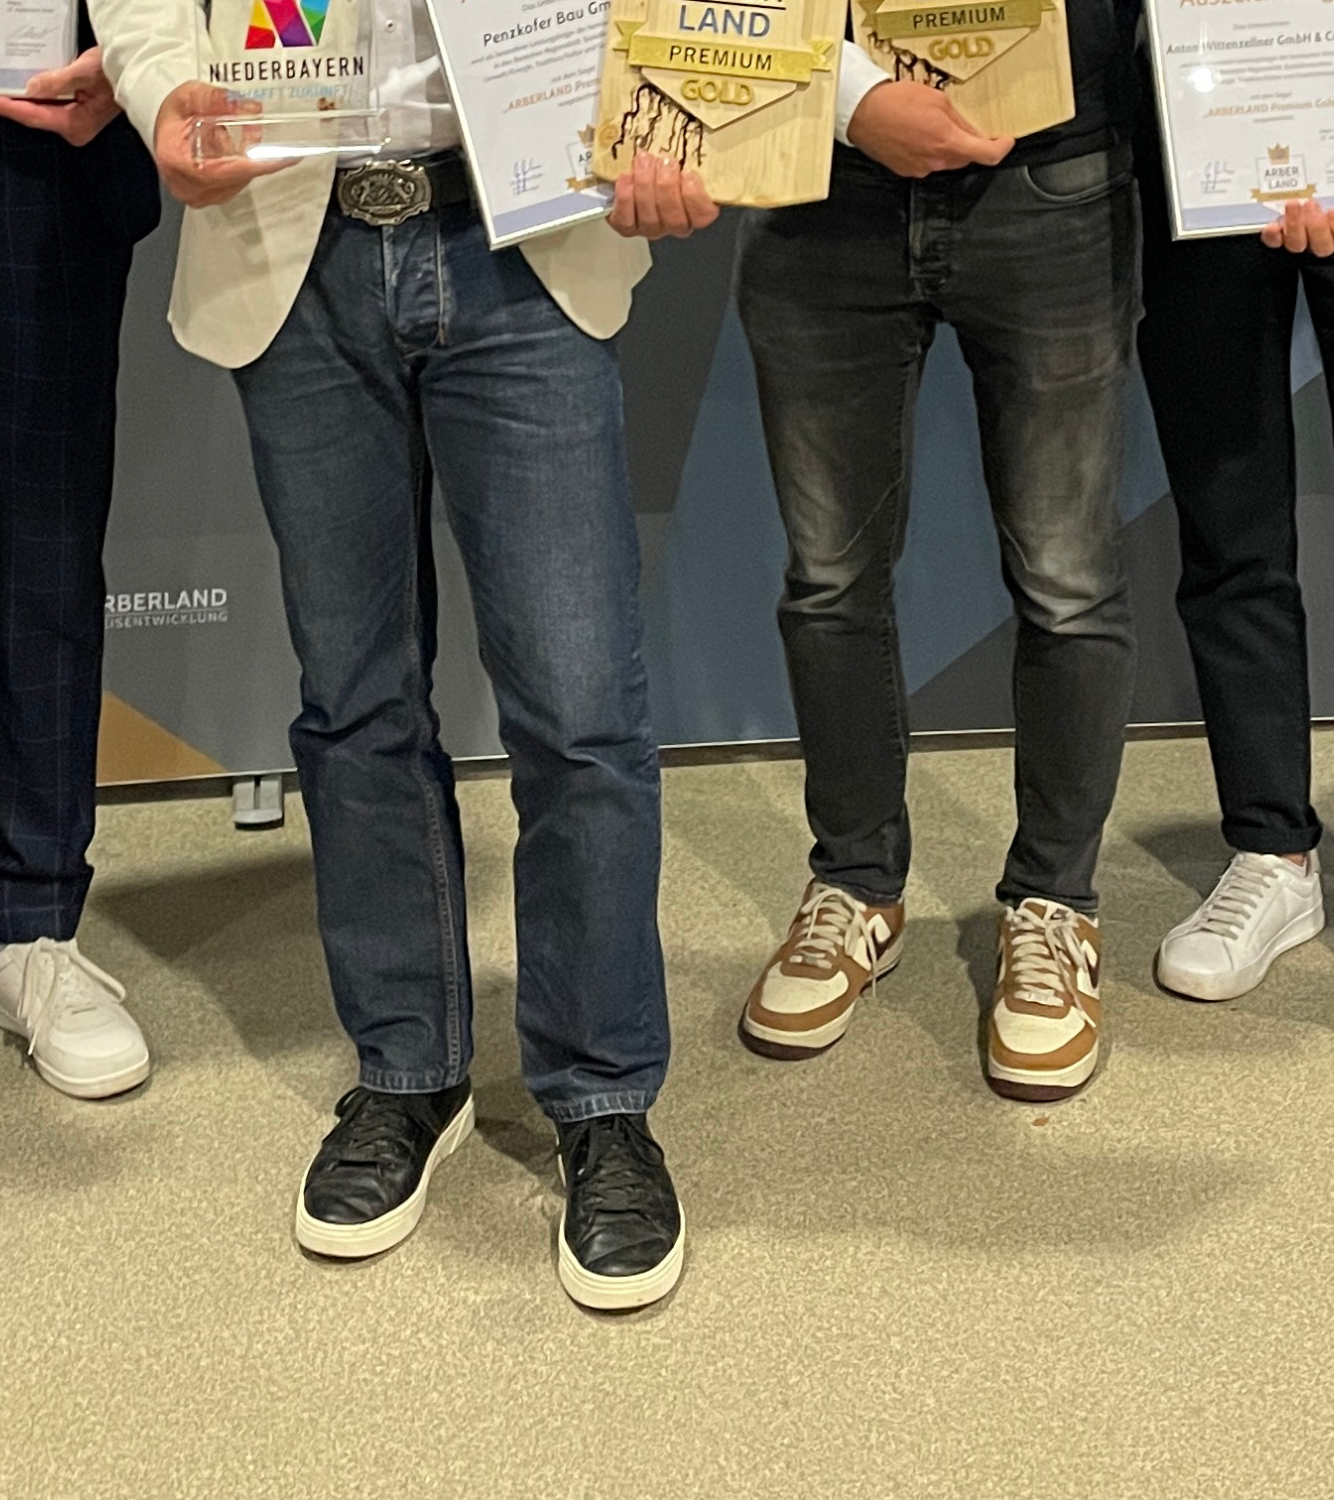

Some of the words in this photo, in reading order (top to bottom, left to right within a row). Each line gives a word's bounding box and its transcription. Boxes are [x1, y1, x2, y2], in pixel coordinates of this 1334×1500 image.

[483, 17, 553, 47] Penzkofer
[556, 8, 584, 25] Bau
[587, 0, 611, 16] Gm
[678, 4, 771, 38] LAND
[912, 6, 1006, 30] PREMIUM
[928, 35, 995, 61] GOLD
[1277, 31, 1312, 46] GmbH
[209, 55, 364, 83] NIEDERBAYERN
[669, 44, 773, 72] PREMIUM
[680, 78, 755, 106] GOLD
[104, 587, 227, 613] RBERLAND
[105, 611, 228, 630] ISENTWICKLUNG
